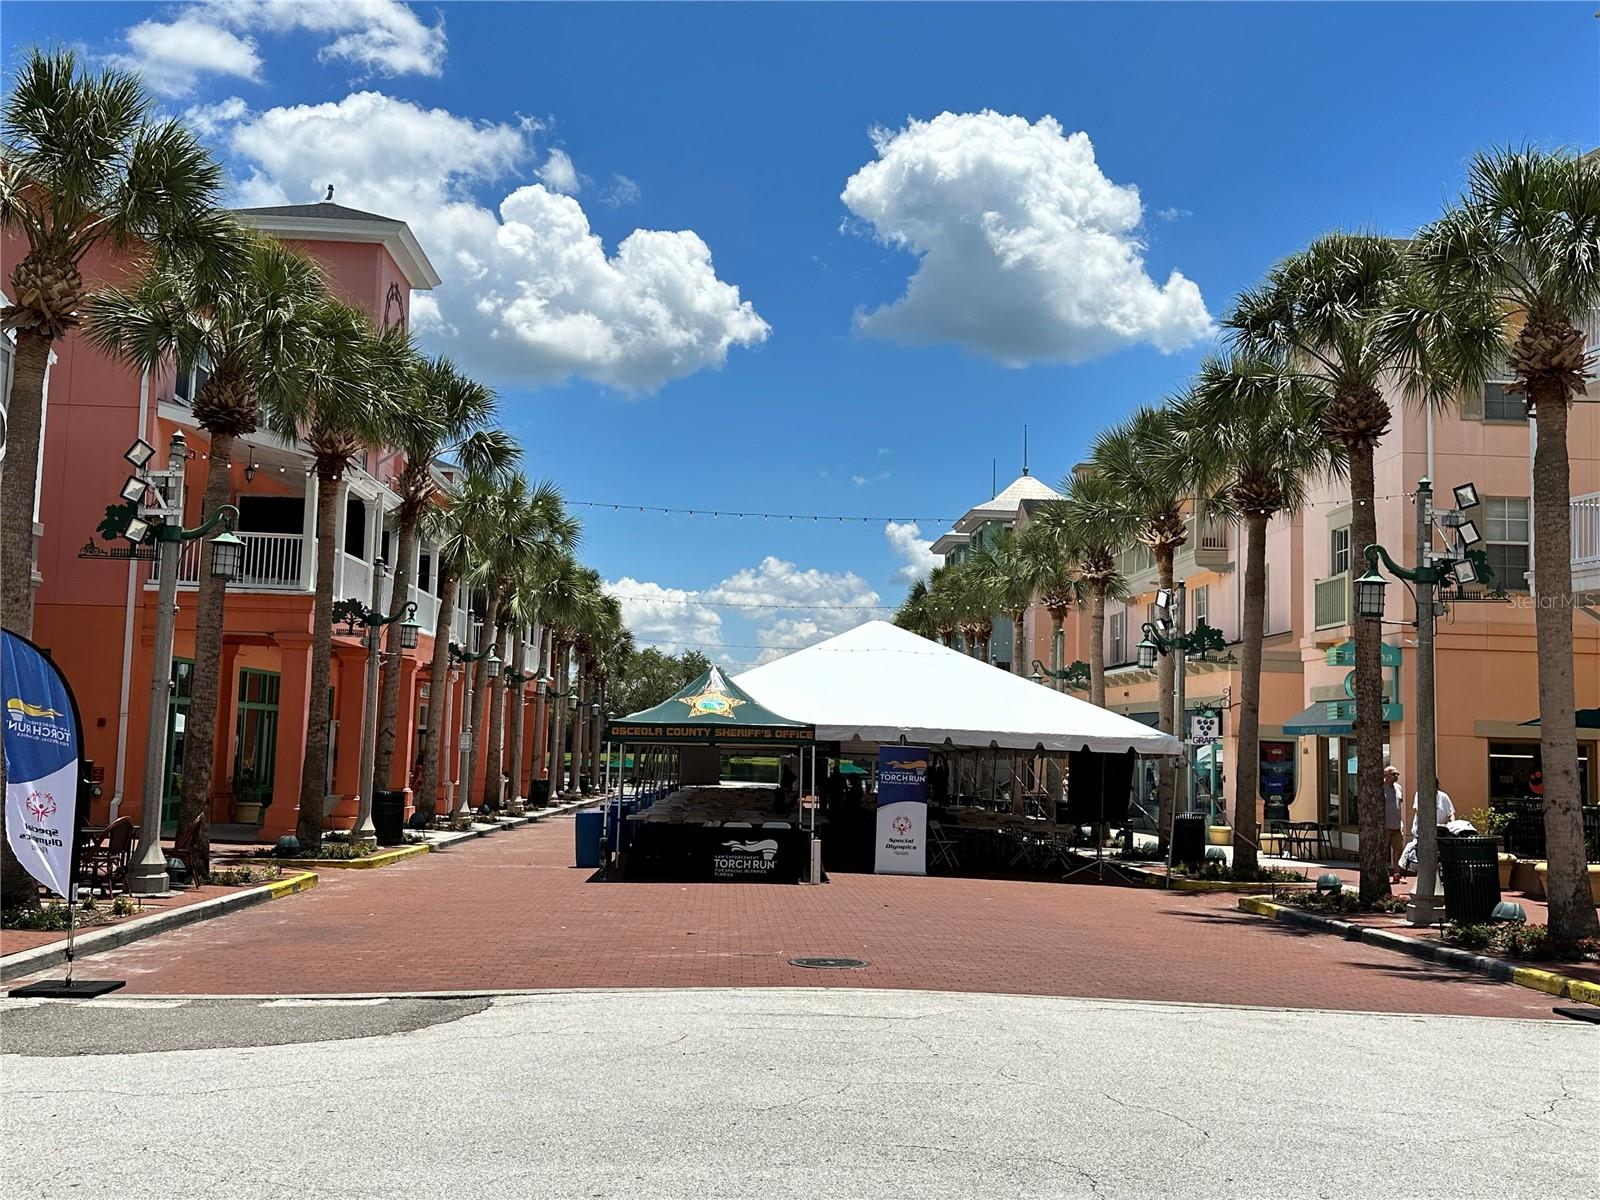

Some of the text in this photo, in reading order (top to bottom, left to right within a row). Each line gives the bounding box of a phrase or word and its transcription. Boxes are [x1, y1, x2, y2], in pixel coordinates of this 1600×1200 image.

[611, 727, 814, 739] OSCEOLA COUNTY SHERIFF'S OFFICE
[1192, 736, 1219, 745] GRAPE
[880, 773, 926, 783] TORCH RUN
[714, 859, 775, 870] TORCH RUN
